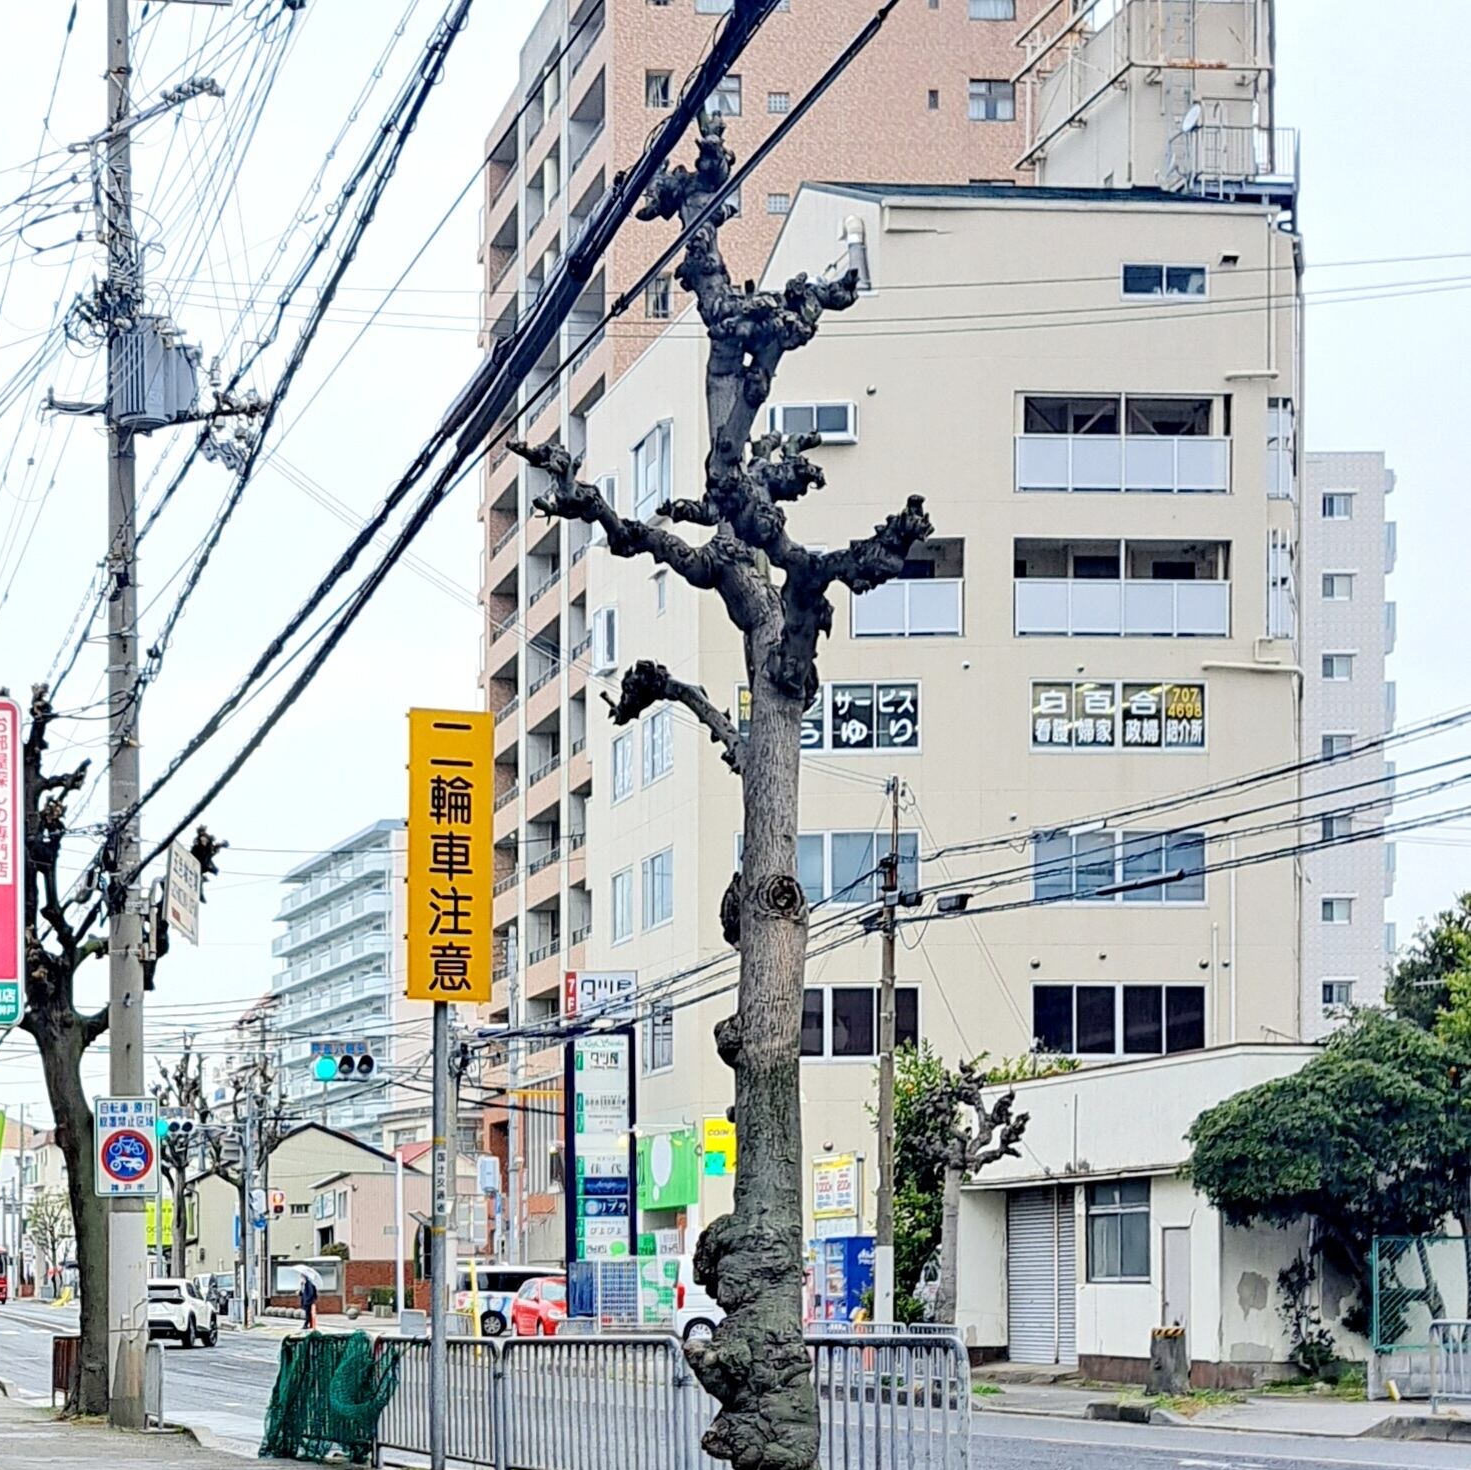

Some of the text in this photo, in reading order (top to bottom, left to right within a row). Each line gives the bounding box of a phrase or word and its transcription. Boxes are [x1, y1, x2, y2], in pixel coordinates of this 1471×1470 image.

[802, 689, 915, 715] サービス
[1040, 689, 1159, 715] 白百合
[1173, 688, 1198, 701] 707
[1168, 703, 1202, 718] 4698
[429, 722, 473, 991] 二輪車注意
